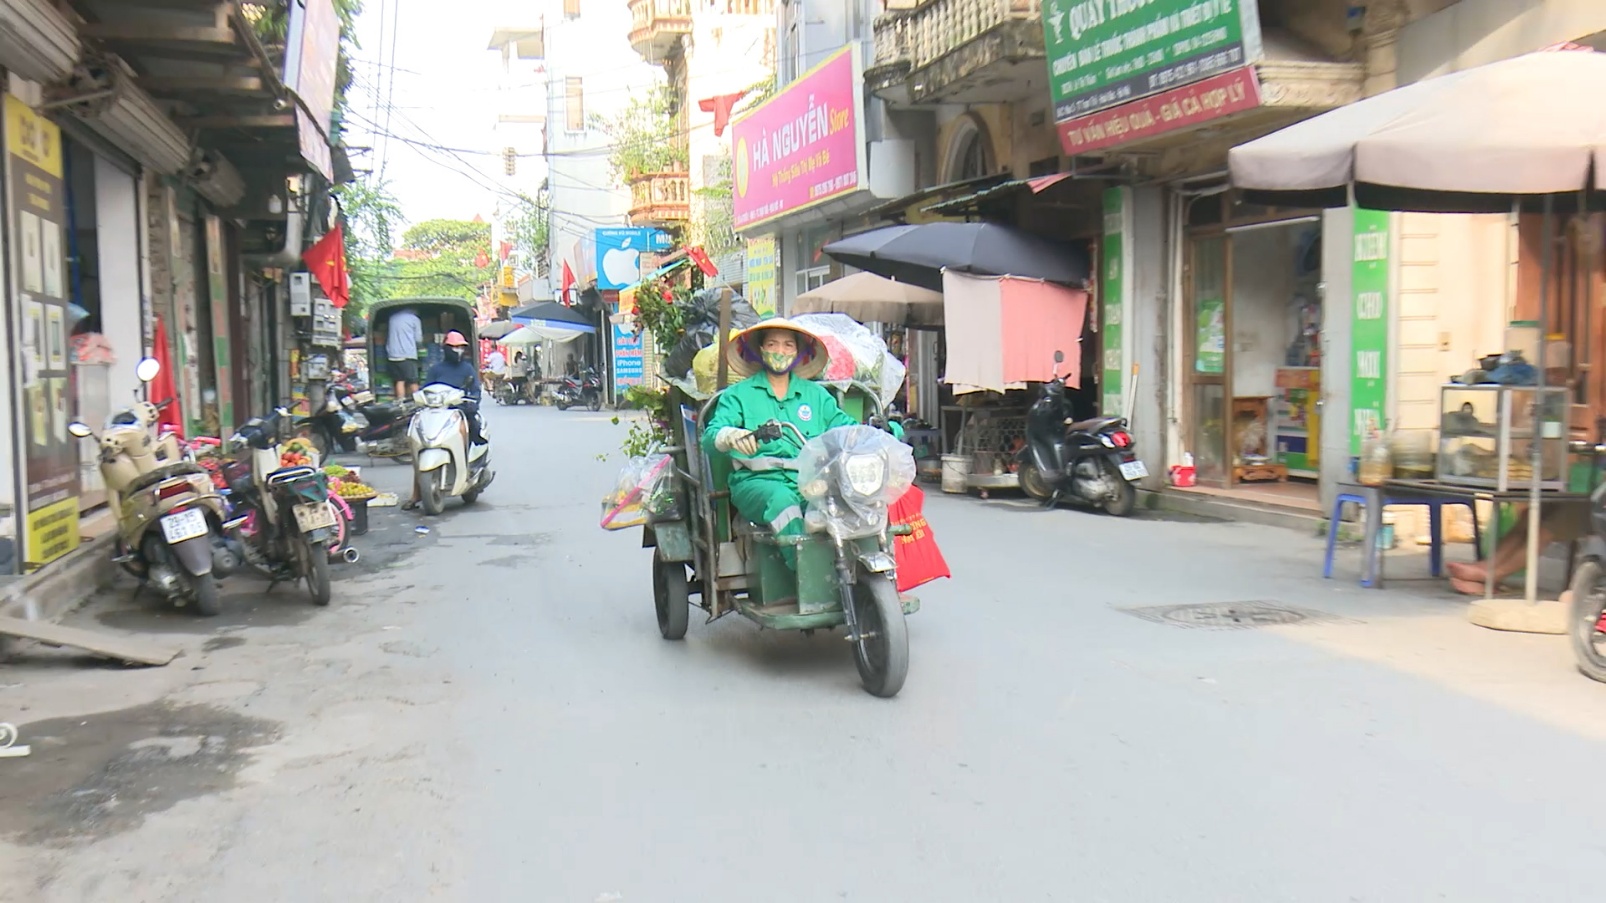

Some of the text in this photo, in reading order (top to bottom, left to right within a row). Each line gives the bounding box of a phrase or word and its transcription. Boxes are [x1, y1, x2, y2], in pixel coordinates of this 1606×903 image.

[753, 94, 849, 171] HÀ NGUYỄN Store
[1130, 104, 1156, 130] QUẢ
[1160, 99, 1183, 122] GIÁ
[1229, 77, 1246, 101] LÝ
